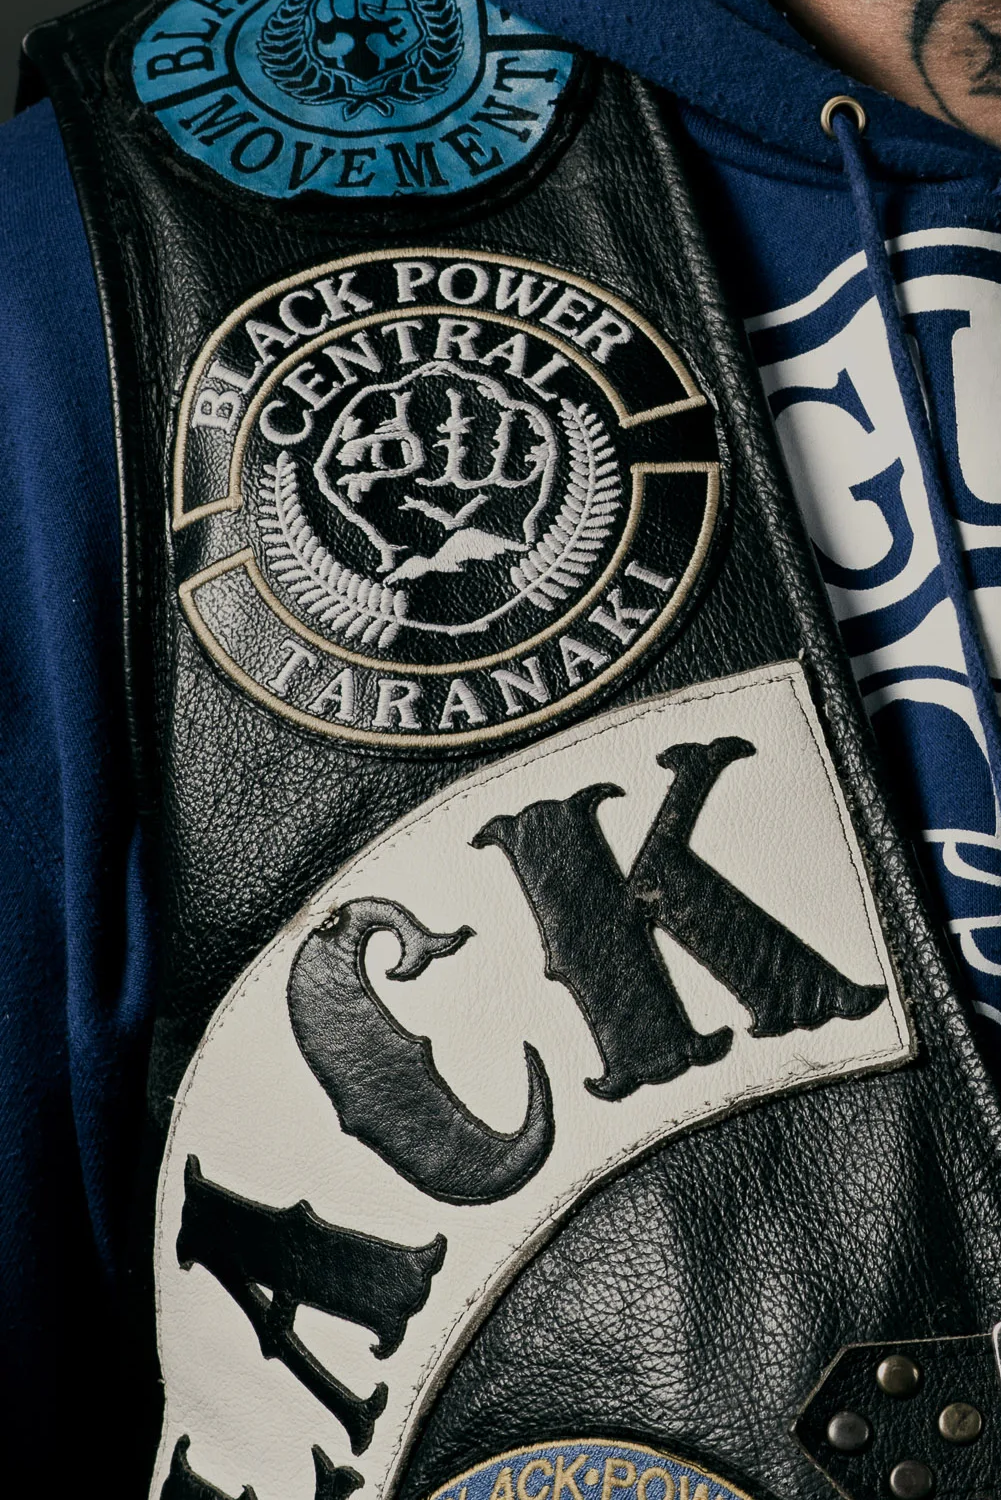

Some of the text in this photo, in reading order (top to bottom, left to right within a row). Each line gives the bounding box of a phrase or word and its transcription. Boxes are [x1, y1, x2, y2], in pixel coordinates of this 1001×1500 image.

[180, 56, 558, 190] MOVEMENT
[192, 260, 634, 432] BLACK POWER
[258, 317, 572, 446] CENTRAL
[265, 560, 675, 729] TARANAKI
